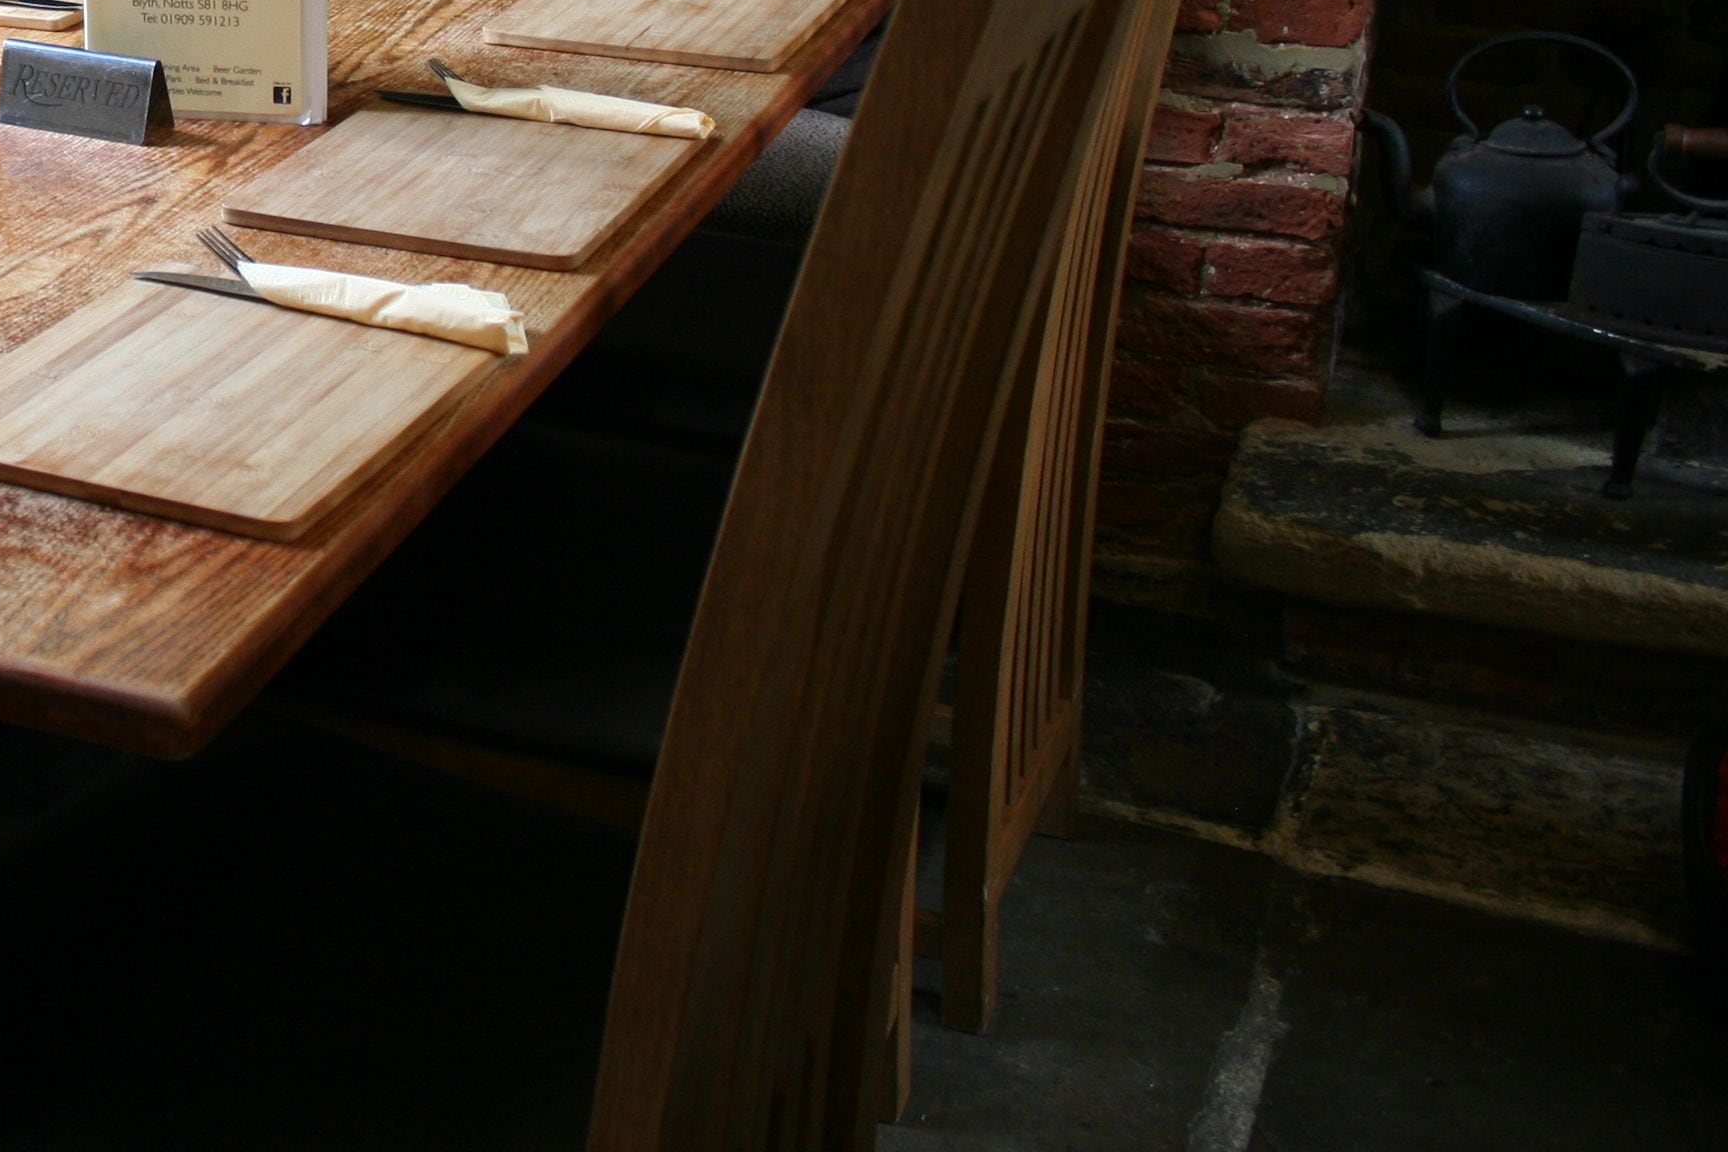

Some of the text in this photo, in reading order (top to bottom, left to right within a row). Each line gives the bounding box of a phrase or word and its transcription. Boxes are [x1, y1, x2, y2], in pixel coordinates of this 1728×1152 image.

[198, 0, 216, 10] S81
[221, 0, 249, 12] 8HG
[141, 13, 240, 27] Tel: 01909 591213
[182, 63, 201, 73] Area
[213, 65, 230, 74] Beer
[233, 66, 262, 76] Garden
[8, 63, 140, 110] RESERVED
[196, 77, 210, 86] Bed
[212, 78, 218, 86] &
[221, 78, 255, 87] Breakfast
[186, 88, 223, 97] Welcome
